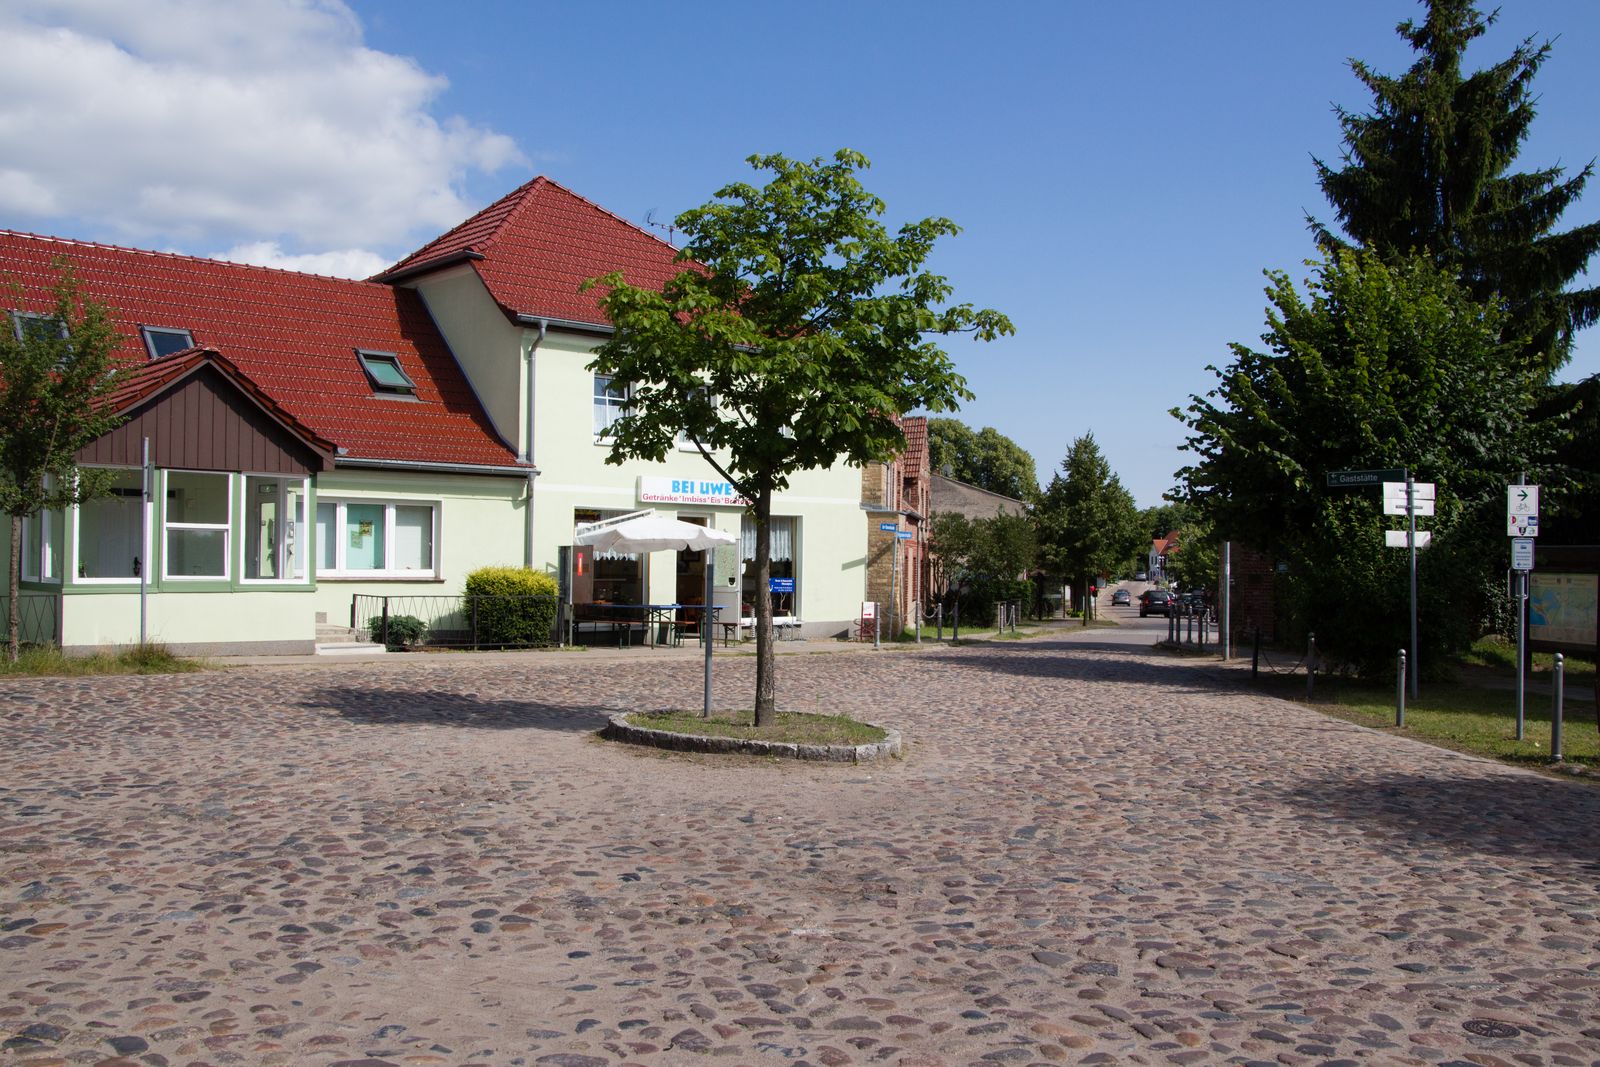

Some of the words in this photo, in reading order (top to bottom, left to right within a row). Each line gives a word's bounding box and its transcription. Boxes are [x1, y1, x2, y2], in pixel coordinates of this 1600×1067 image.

[1339, 473, 1378, 483] Gaststätte
[671, 480, 695, 494] BEI
[699, 481, 732, 495] UWE
